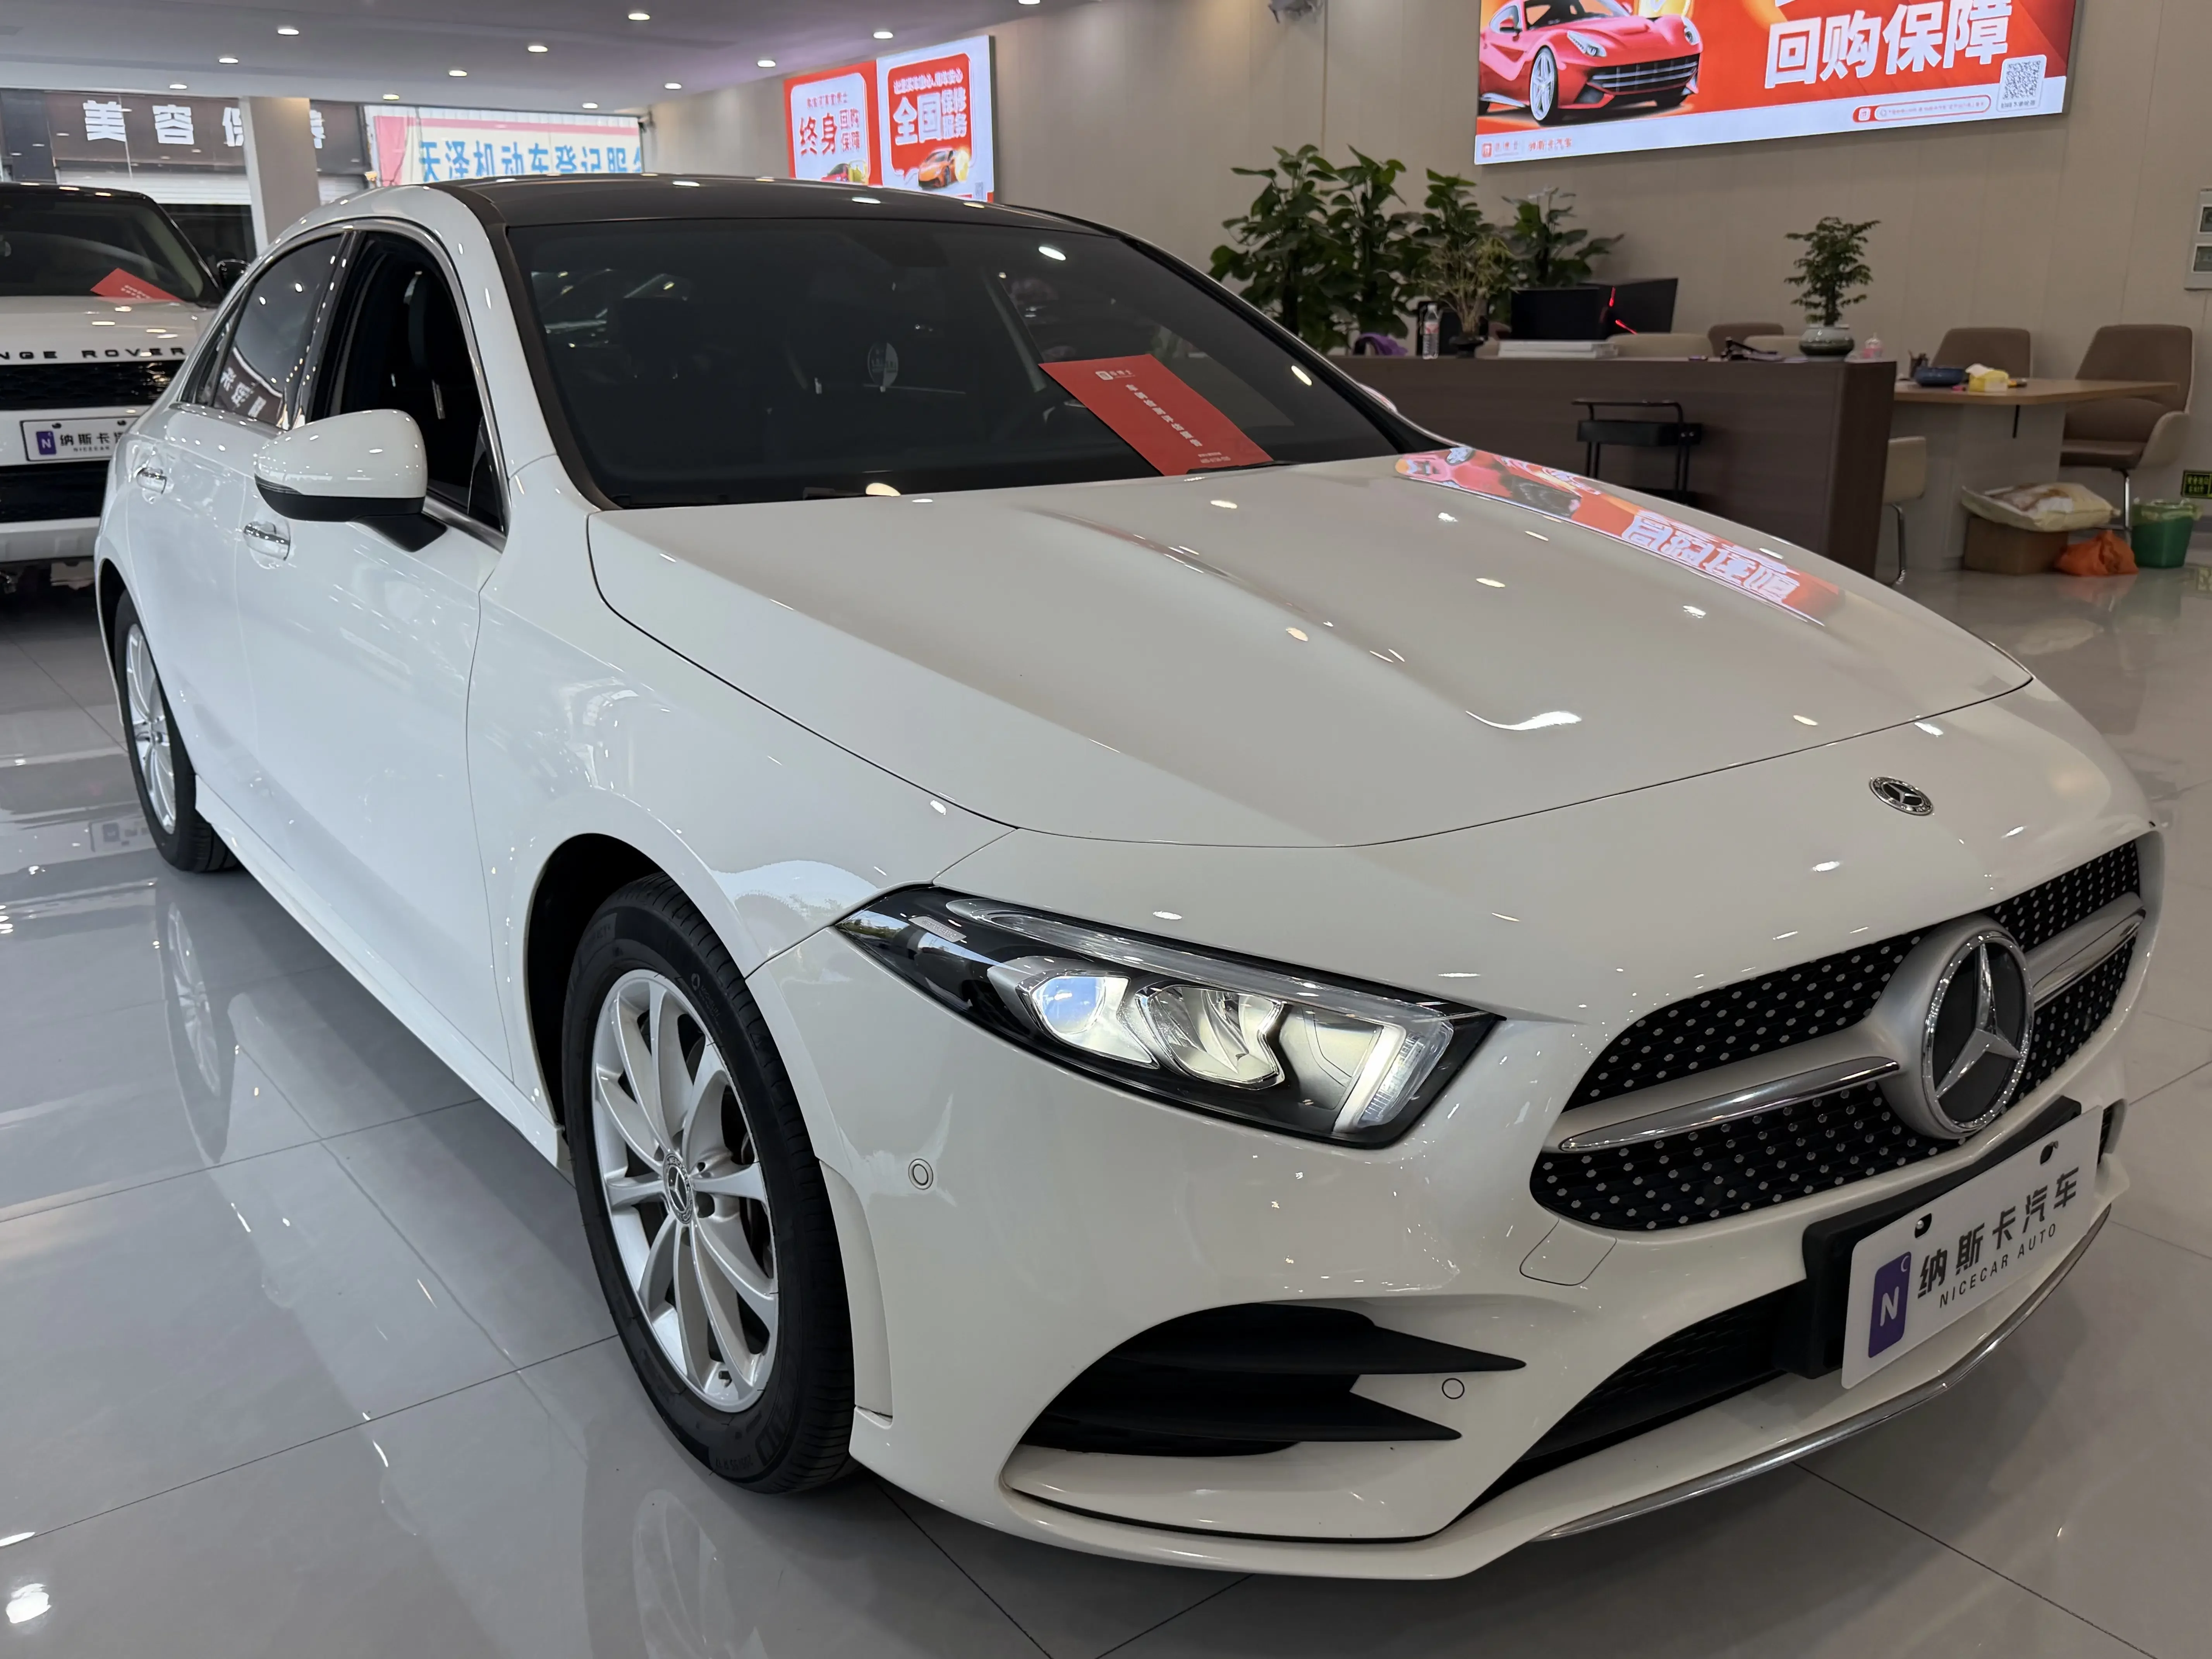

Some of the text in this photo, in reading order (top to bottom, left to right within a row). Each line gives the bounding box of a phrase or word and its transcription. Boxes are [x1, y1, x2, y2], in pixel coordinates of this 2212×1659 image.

[1765, 0, 2012, 89] 回购保障
[800, 112, 838, 156] 终身
[893, 93, 942, 146] 全国
[419, 140, 641, 182] 天泽机动车登记服
[81, 347, 186, 358] ROVER
[1917, 1166, 2079, 1299] 纳斯卡汽车
[1939, 1223, 2056, 1308] NICECAR AUTO
[1880, 1286, 1899, 1327] N
